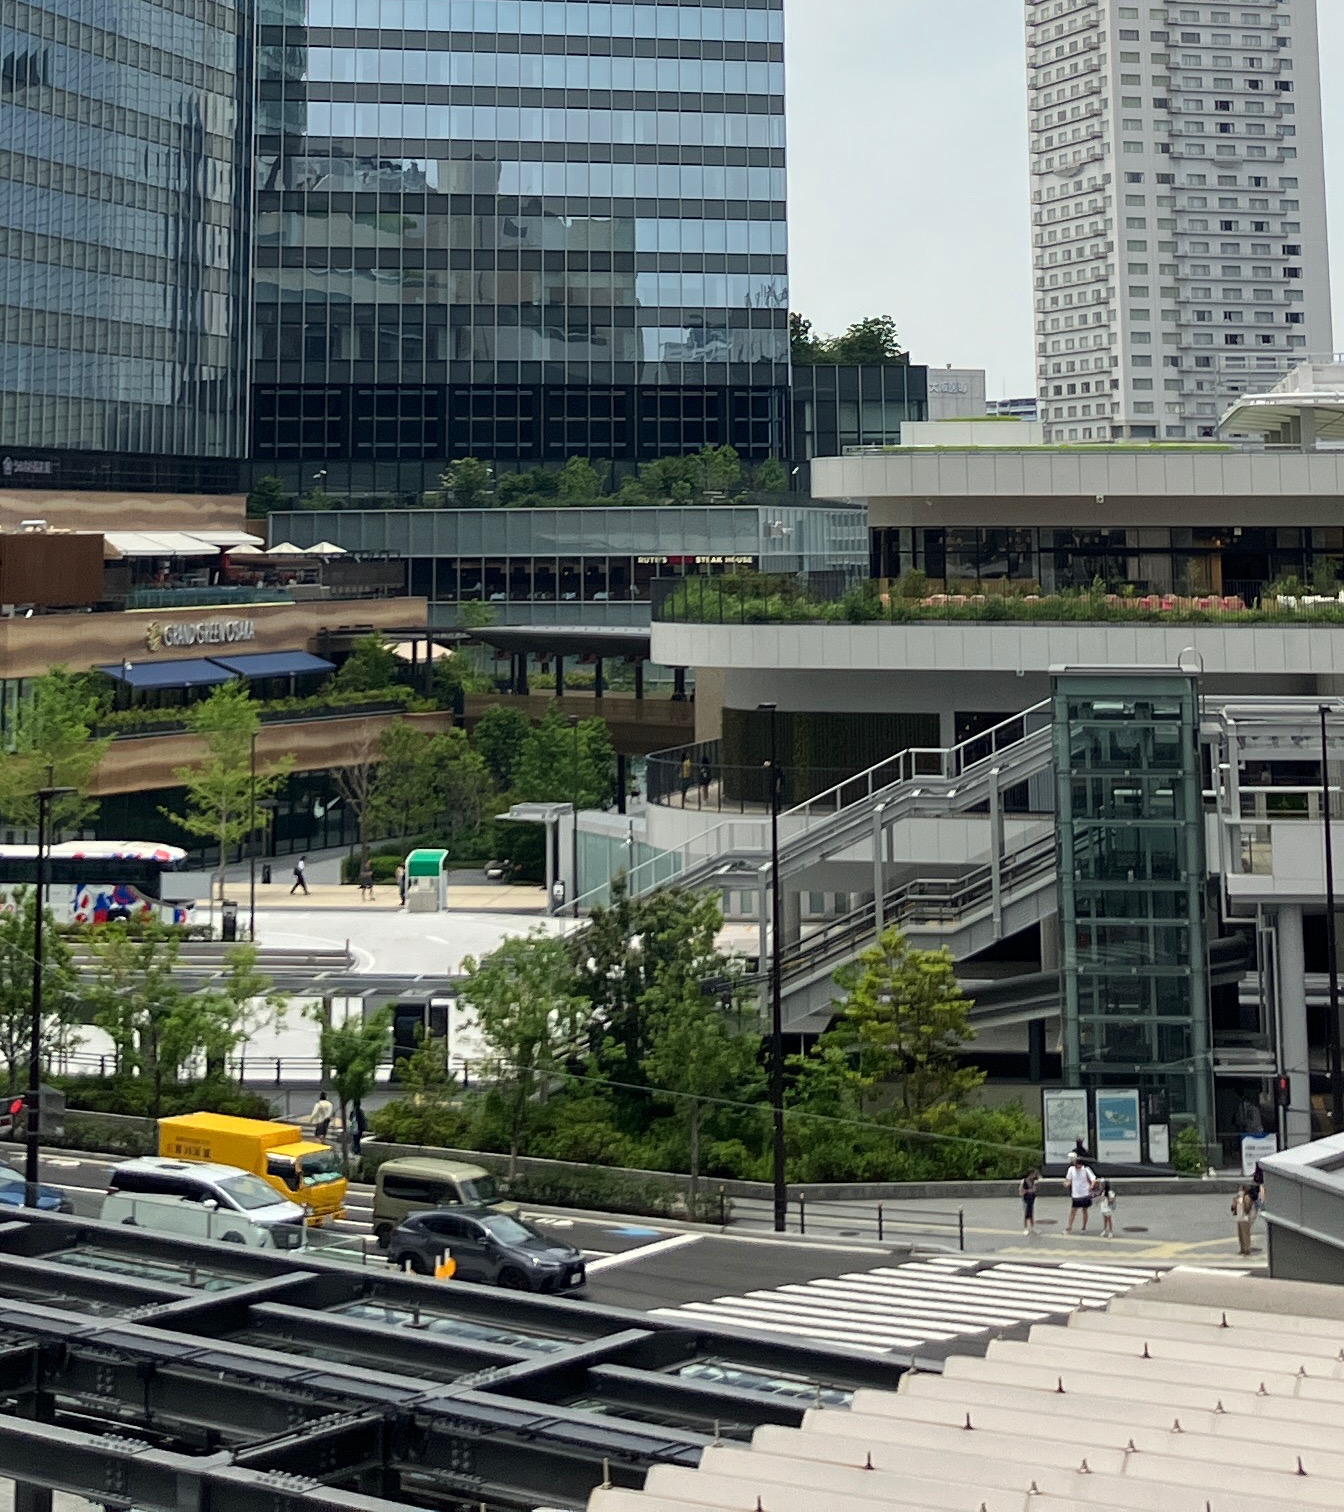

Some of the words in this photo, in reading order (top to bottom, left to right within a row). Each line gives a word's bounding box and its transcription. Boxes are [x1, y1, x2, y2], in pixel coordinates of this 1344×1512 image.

[695, 556, 723, 564] STEAK
[725, 556, 753, 564] HOUSE
[163, 623, 195, 647] GRAND
